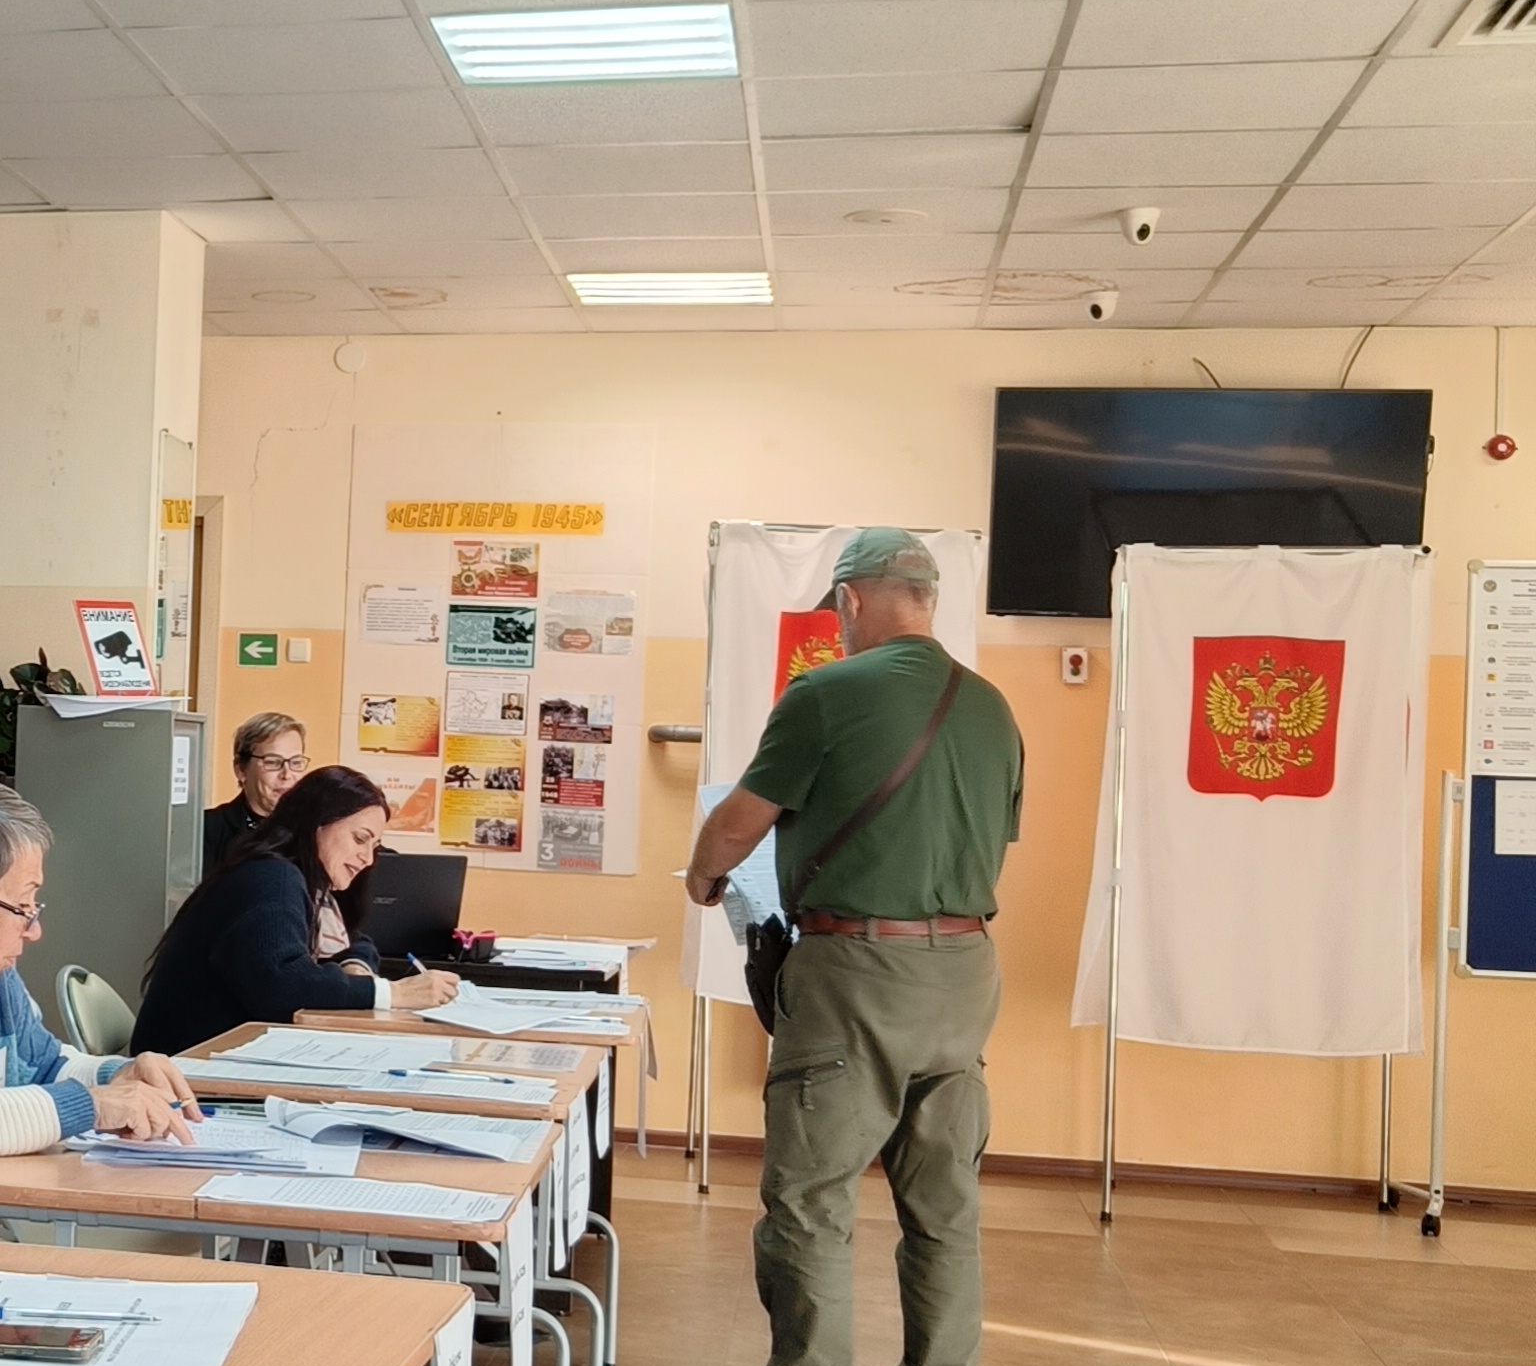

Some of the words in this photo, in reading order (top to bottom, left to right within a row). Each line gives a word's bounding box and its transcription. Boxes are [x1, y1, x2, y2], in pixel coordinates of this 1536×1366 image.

[386, 502, 517, 529] «СЕНТЯБРЬ
[531, 503, 604, 530] 1945»
[82, 609, 135, 623] ВНИМАНИЕ
[452, 644, 476, 655] Вторая
[478, 646, 507, 657] мировая
[508, 646, 529, 656] война
[541, 842, 555, 861] 3
